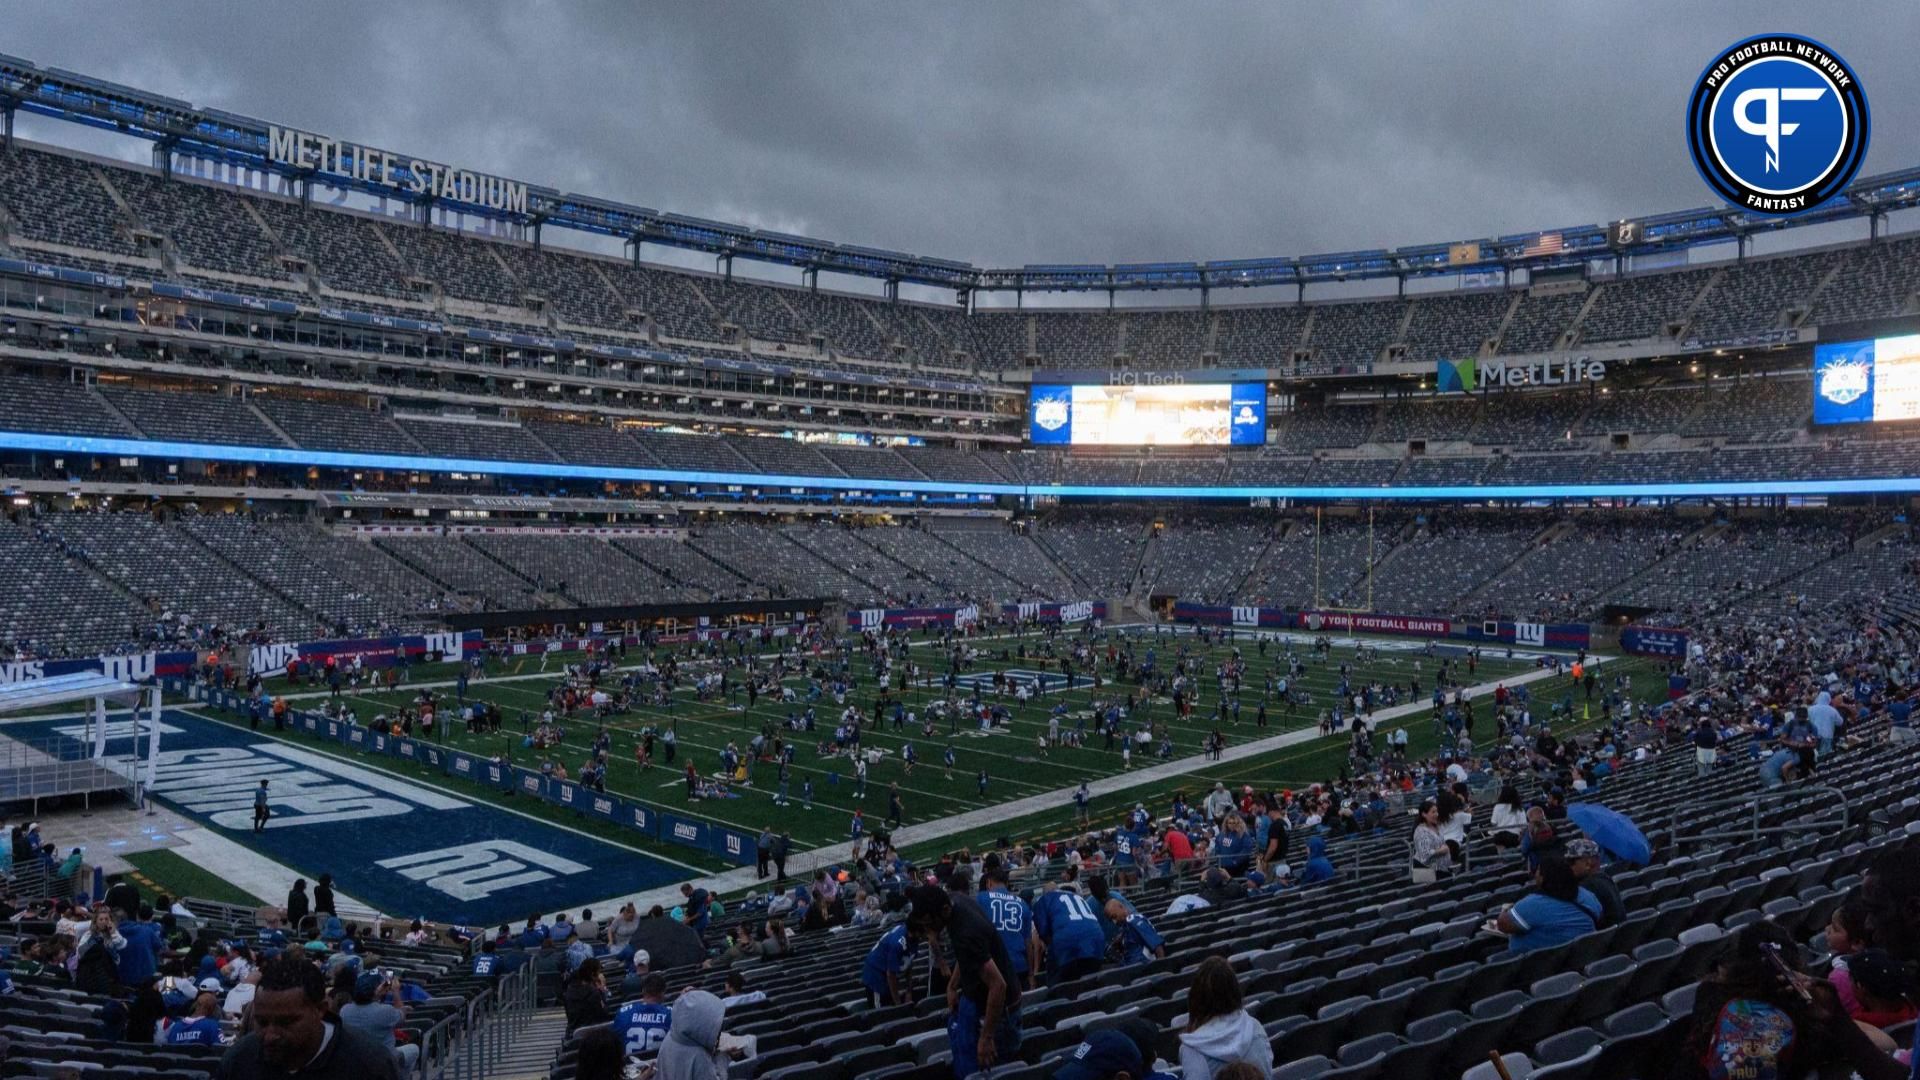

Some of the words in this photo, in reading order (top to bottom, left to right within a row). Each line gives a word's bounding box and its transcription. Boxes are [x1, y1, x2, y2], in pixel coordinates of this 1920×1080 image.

[268, 125, 399, 188] METLIFE
[410, 160, 528, 214] STADIUM
[1109, 371, 1185, 386] HCLTech
[1480, 356, 1607, 386] MetLife
[1303, 616, 1326, 627] NW
[1328, 616, 1352, 628] YORK
[1356, 618, 1405, 630] FOOTBALL
[1408, 621, 1444, 632] GIANTS
[674, 821, 697, 837] GIANTS
[990, 898, 1023, 932] 13
[476, 961, 491, 974] 26
[632, 1012, 667, 1024] BARKLEY
